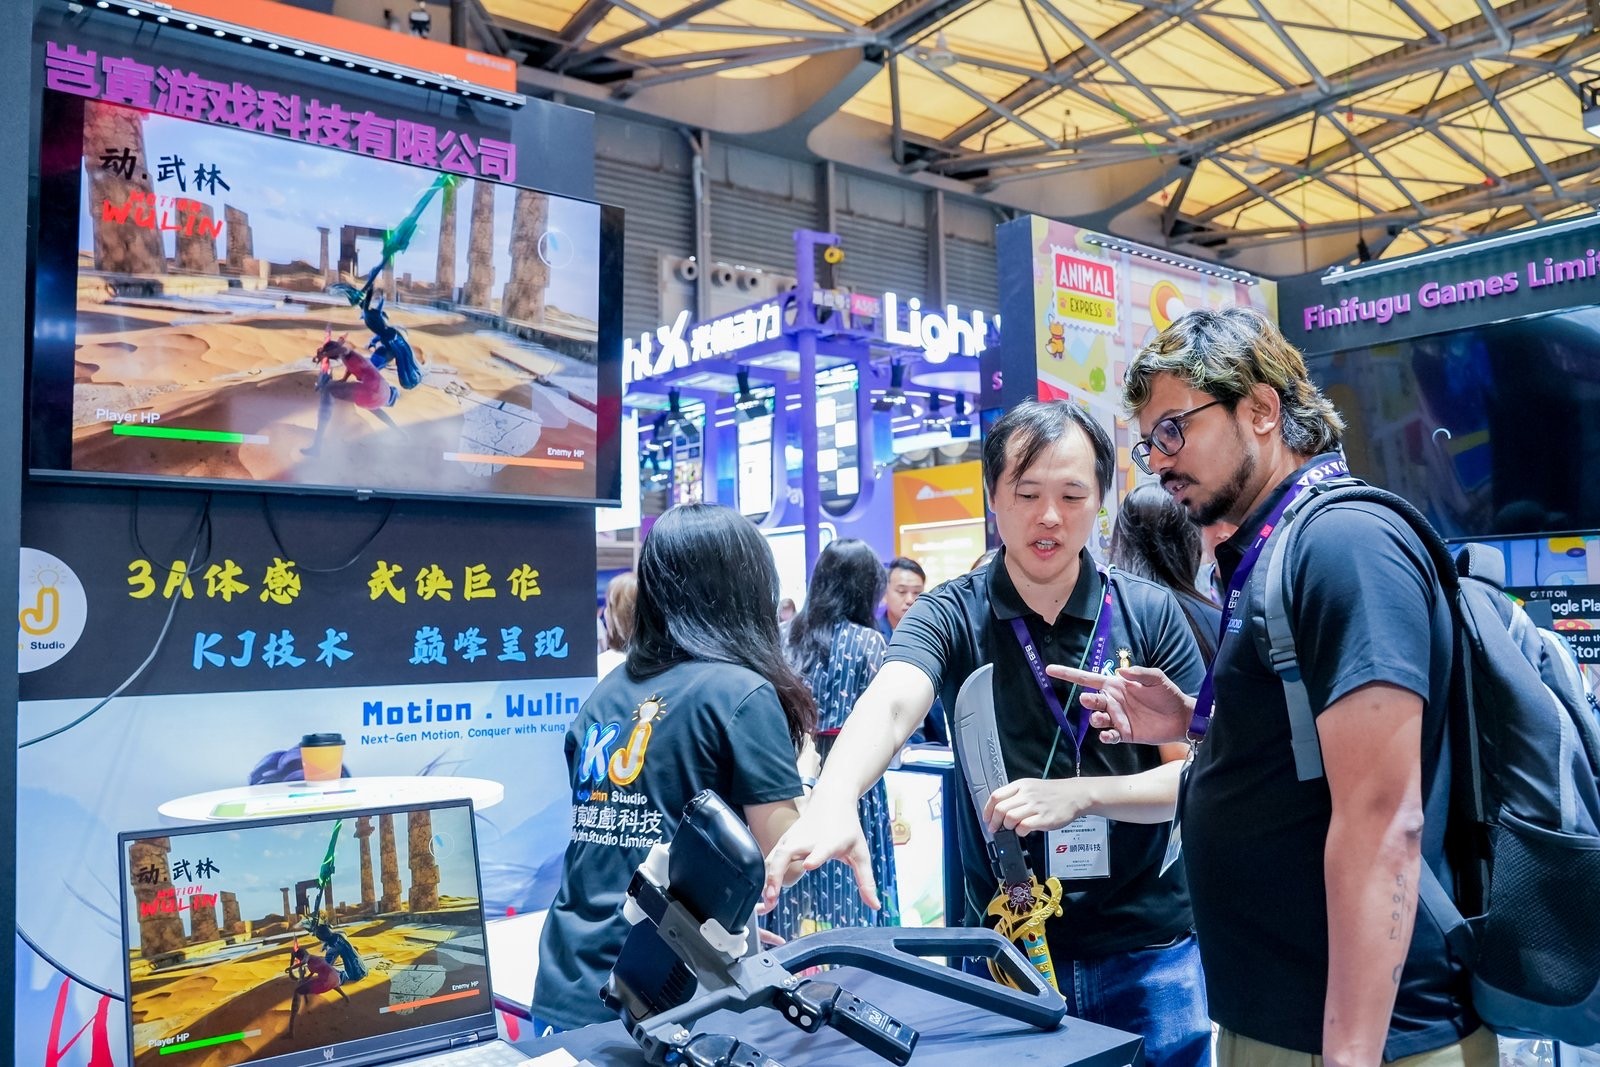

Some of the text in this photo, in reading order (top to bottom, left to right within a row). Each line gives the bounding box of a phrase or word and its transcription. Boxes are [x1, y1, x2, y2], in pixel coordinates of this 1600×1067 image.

[102, 199, 223, 239] WULIN
[1059, 261, 1112, 297] ANIMAL
[1070, 298, 1103, 318] EXPRESS
[1303, 293, 1411, 331] Finifugu
[1418, 271, 1519, 309] Games
[884, 292, 1001, 364] Light
[96, 408, 161, 424] Player HP
[547, 447, 585, 458] Enemy HP
[127, 557, 542, 604] 3A体感 武侠巨作
[1554, 590, 1567, 598] ON
[30, 641, 65, 650] Studio
[192, 626, 569, 670] KJ技术 巅峰呈现
[362, 699, 472, 727] Motion
[506, 692, 579, 718] Wulin
[361, 732, 417, 746] Next-Gen
[421, 729, 464, 741] Motion,
[468, 726, 513, 739] Conquer
[514, 723, 537, 735] with
[540, 723, 566, 735] Kung
[579, 721, 652, 786] KJ
[611, 790, 648, 805] Studio
[140, 893, 218, 918] WULIN
[148, 1033, 190, 1048] Player HP
